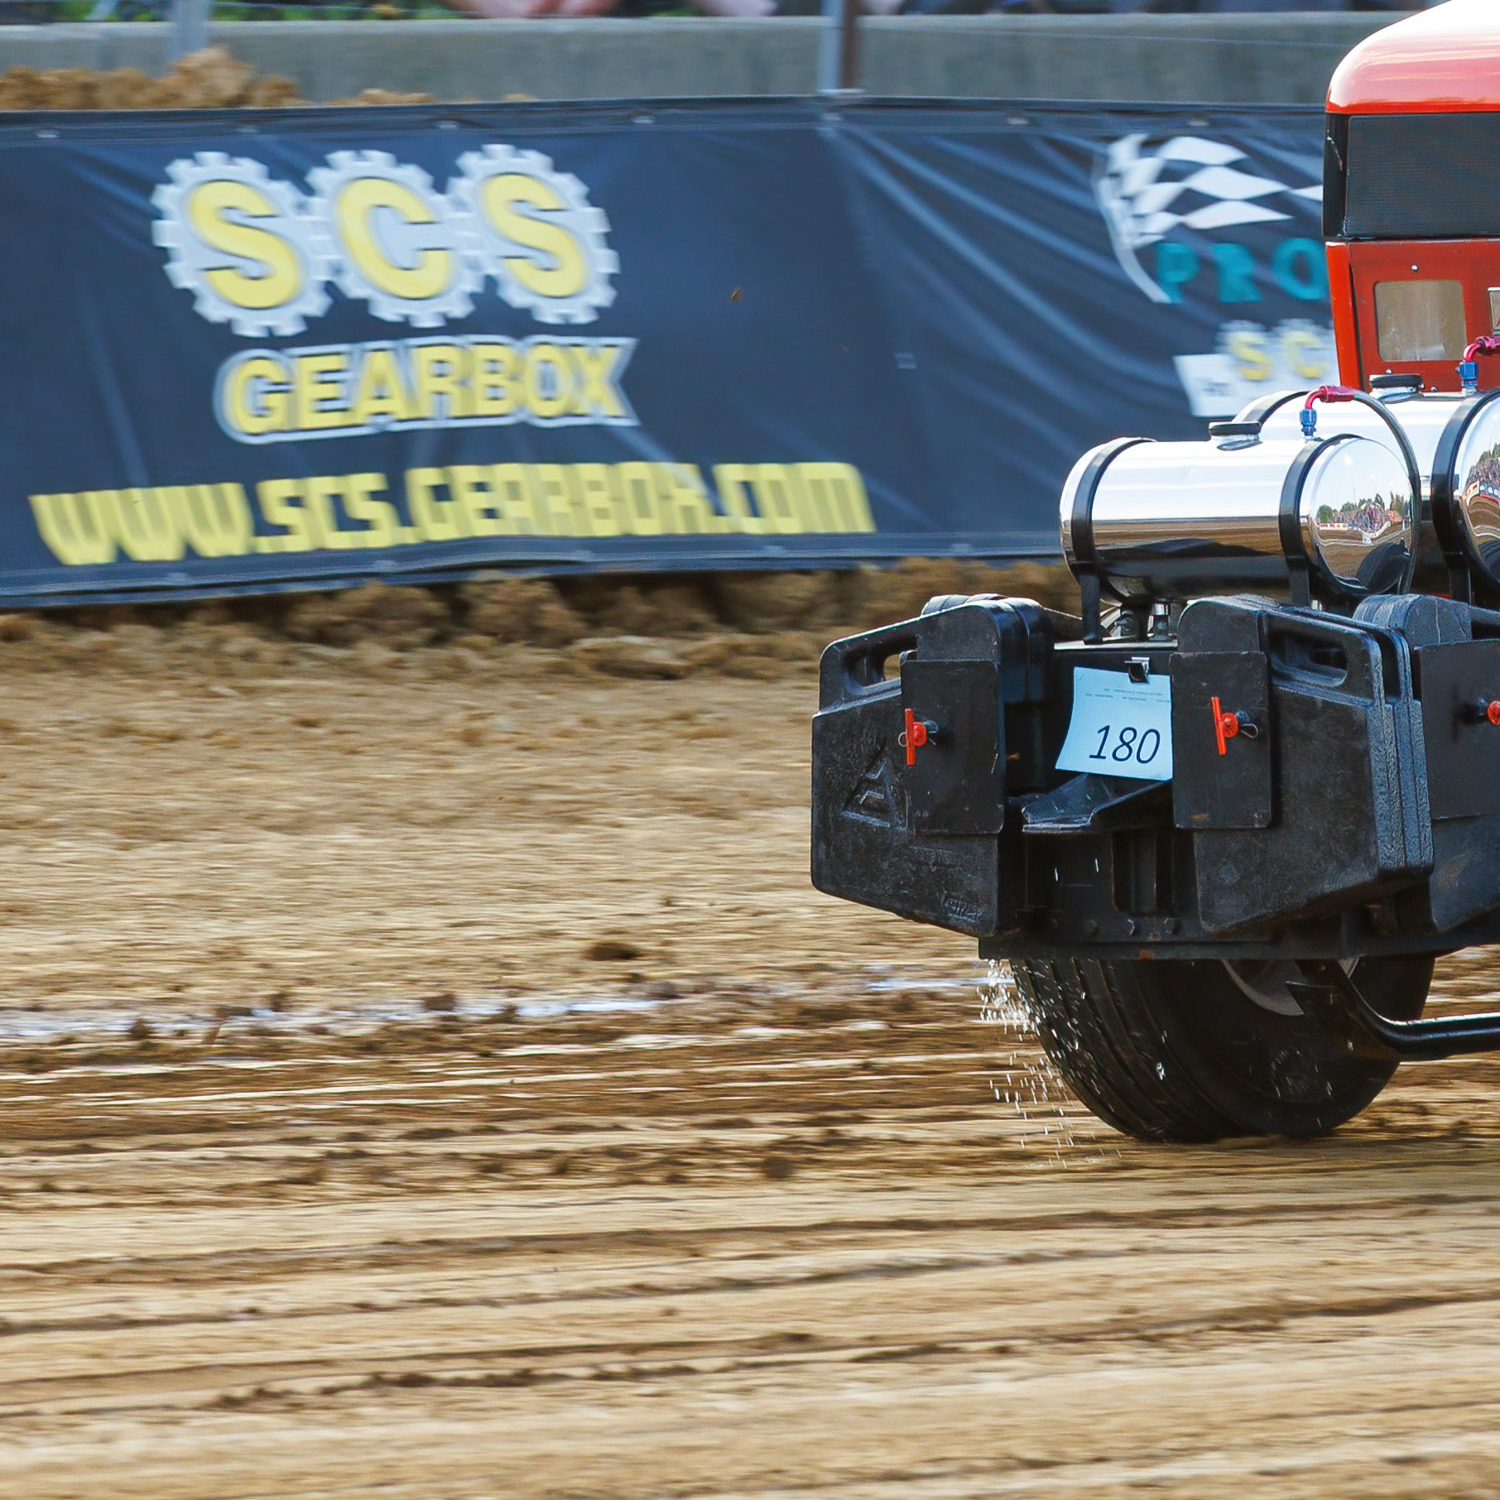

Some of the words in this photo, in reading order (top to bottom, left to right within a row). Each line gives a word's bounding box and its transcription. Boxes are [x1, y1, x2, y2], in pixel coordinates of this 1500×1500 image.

[186, 168, 592, 309] SCS
[230, 343, 632, 432] GEARBOX
[1089, 724, 1161, 764] 180
